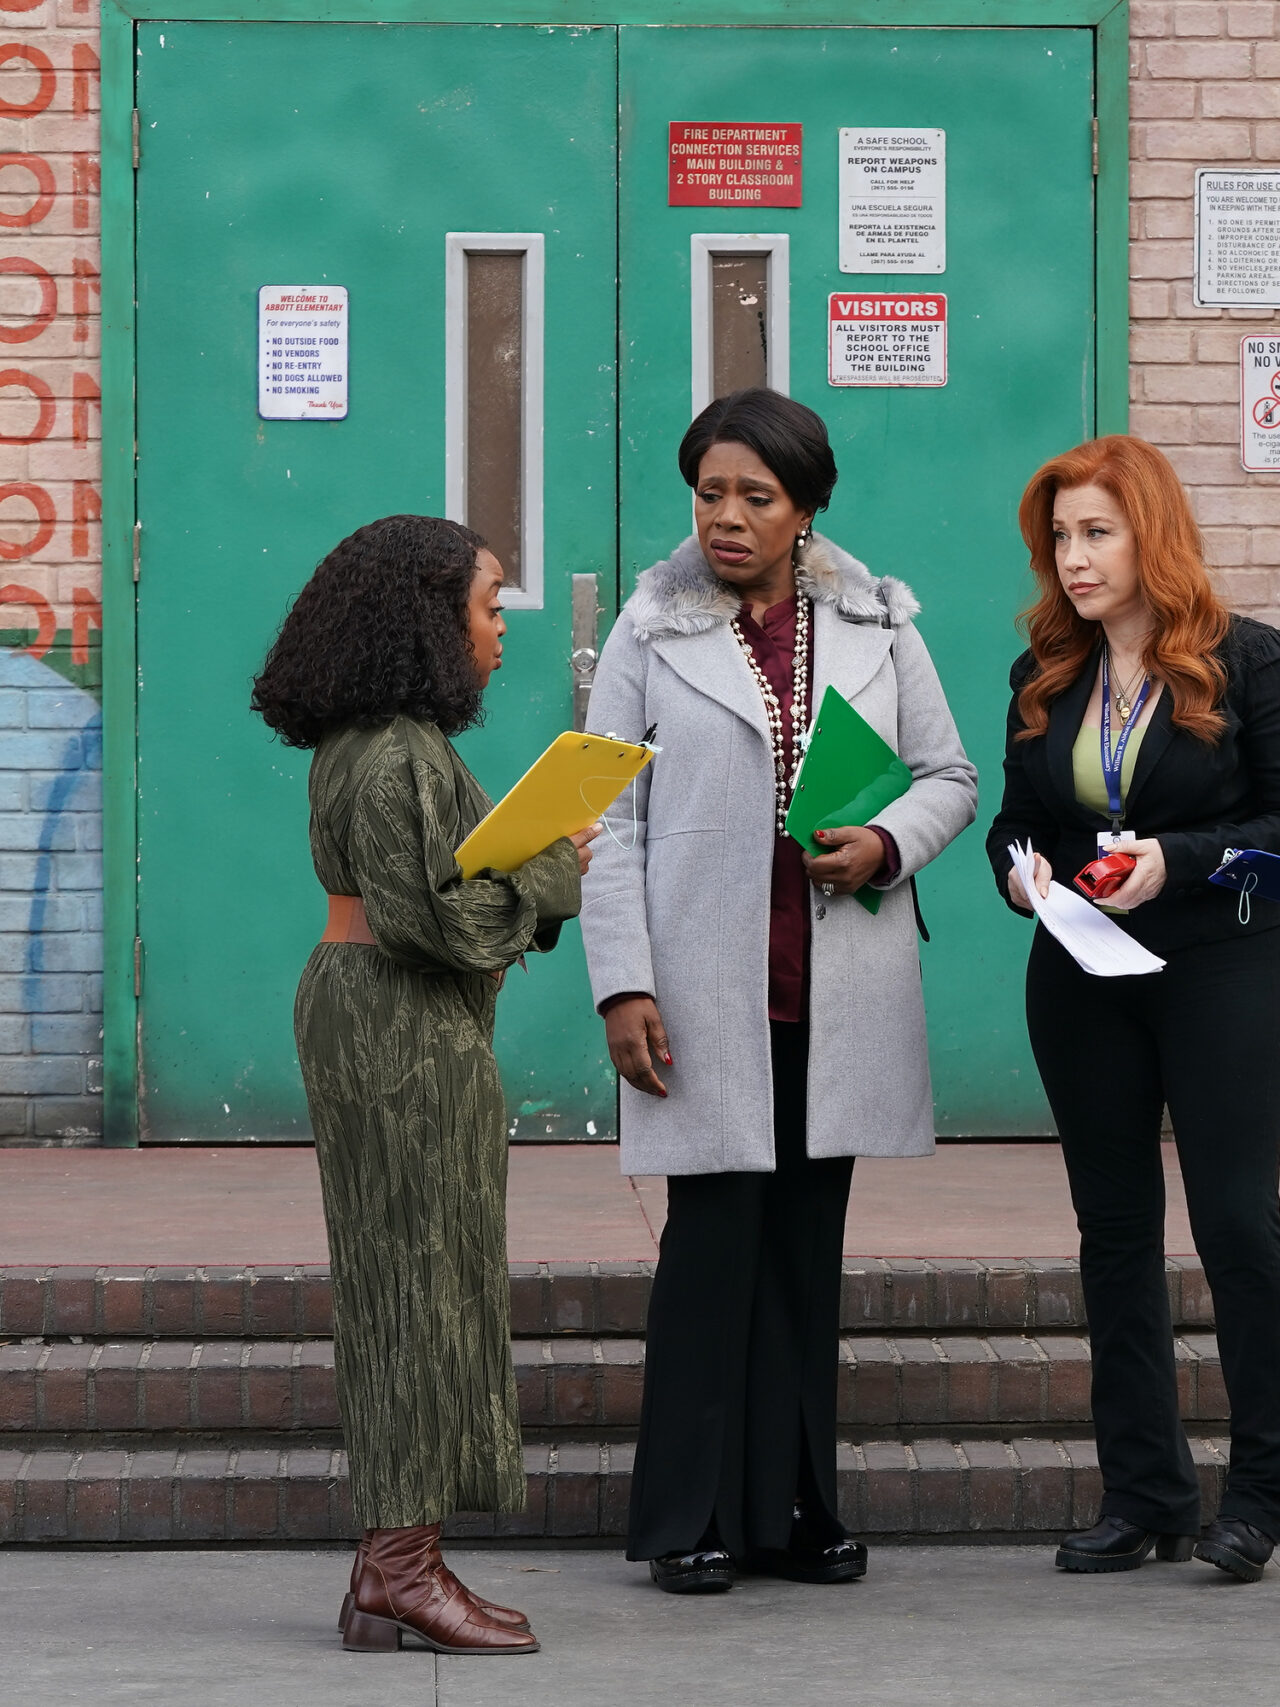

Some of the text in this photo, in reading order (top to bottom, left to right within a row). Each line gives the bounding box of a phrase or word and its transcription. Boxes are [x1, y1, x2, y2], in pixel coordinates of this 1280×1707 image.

[684, 129, 787, 140] FIRE DEPARTMENT
[891, 137, 927, 145] SCHOOL
[672, 143, 799, 156] CONNECTION SERVICES
[687, 159, 783, 170] MAIN BUILDING &
[677, 174, 793, 185] 2 STORY CLASSROOM
[1207, 181, 1234, 190] RULES
[1237, 182, 1254, 190] FOR
[1257, 182, 1273, 190] USE
[709, 189, 761, 200] BUILDING
[281, 295, 317, 303] WELCOME
[838, 301, 938, 316] VISITORS
[280, 320, 317, 328] everyone's
[320, 320, 340, 328] safety
[1248, 342, 1264, 353] NO
[1255, 356, 1270, 367] NO
[875, 364, 925, 372] BUILDING
[272, 374, 342, 382] NO DOGS ALLOWED
[272, 386, 319, 394] NO SMOKING
[328, 401, 343, 409] You
